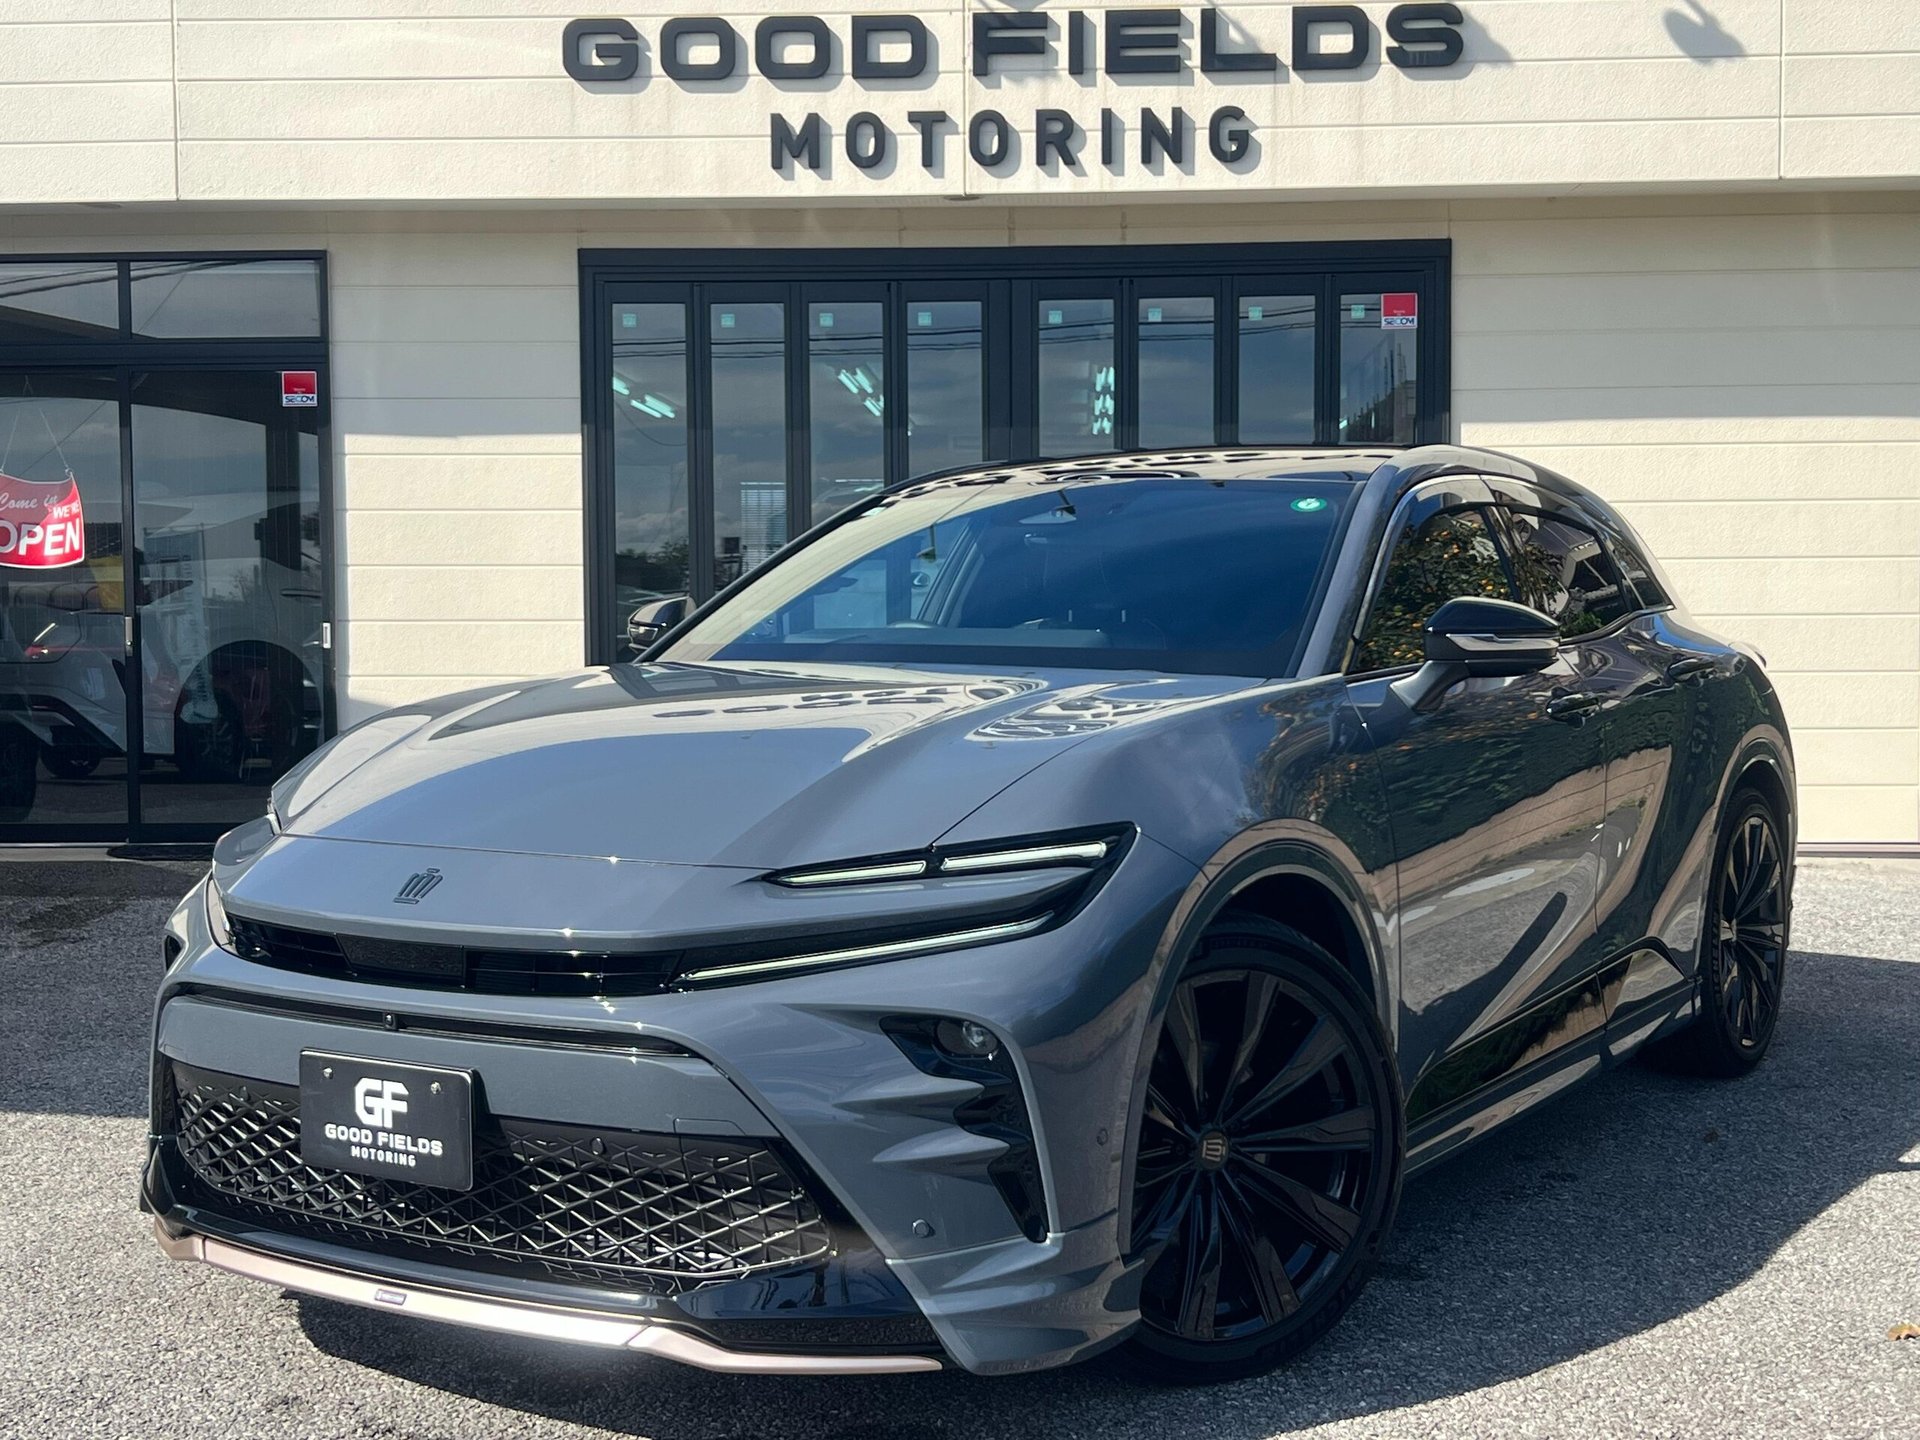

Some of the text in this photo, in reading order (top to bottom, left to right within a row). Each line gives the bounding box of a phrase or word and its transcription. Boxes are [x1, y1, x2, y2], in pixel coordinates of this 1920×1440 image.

[563, 2, 1464, 81] GOOD FIELDS
[770, 106, 1250, 170] MOTORING
[1384, 317, 1415, 326] SECOM
[0, 492, 58, 511] Come in
[0, 517, 80, 556] OPEN
[355, 1077, 409, 1129] GF
[324, 1122, 443, 1156] GOOD FIELDS
[351, 1145, 417, 1168] MOTORING
